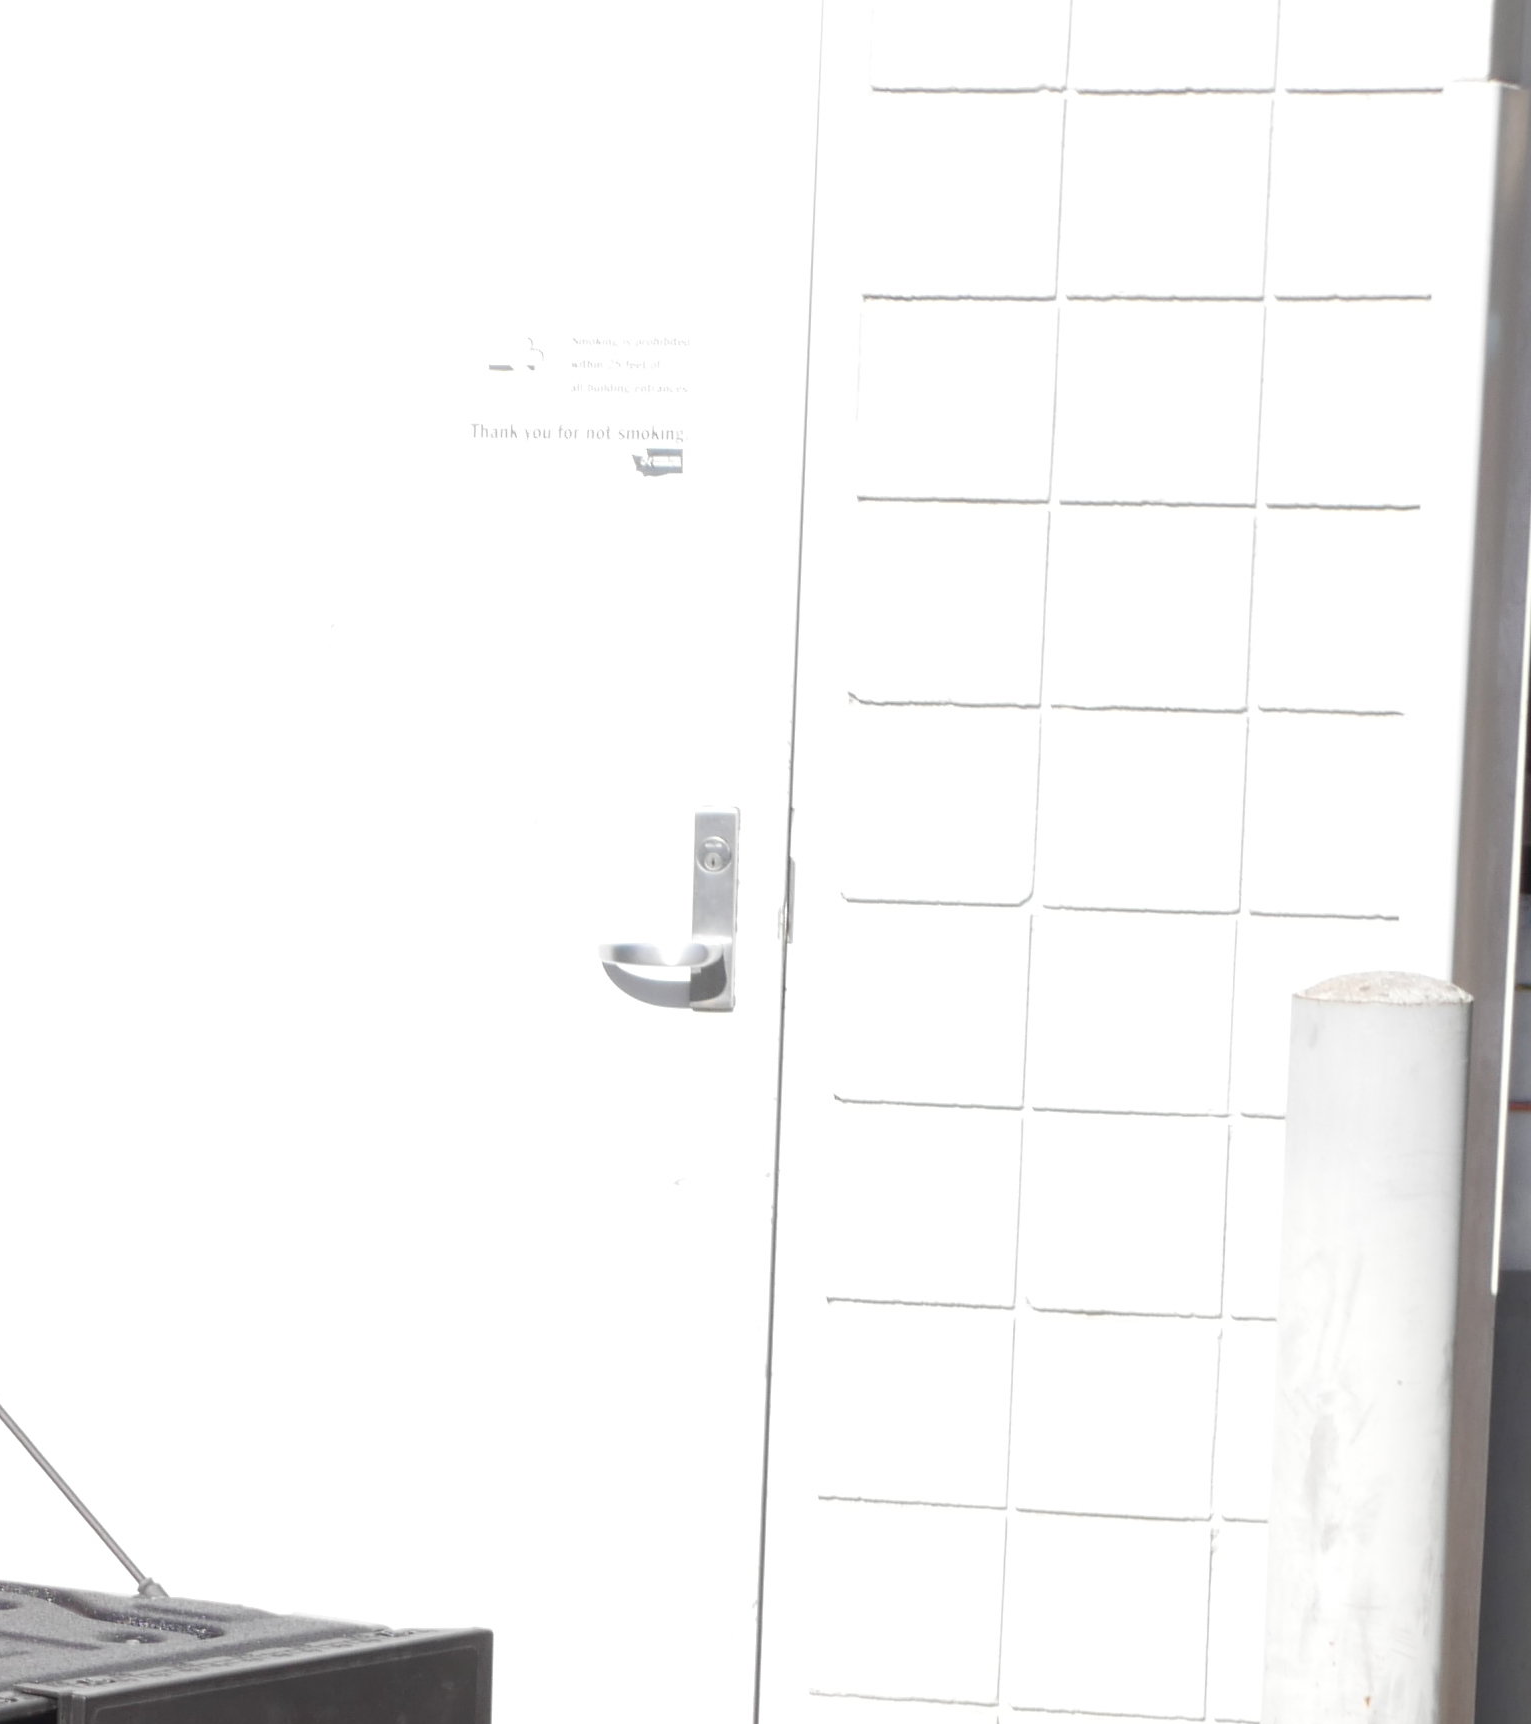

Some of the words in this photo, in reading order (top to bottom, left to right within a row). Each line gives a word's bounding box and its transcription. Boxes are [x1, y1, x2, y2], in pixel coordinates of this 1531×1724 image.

[471, 422, 518, 440] Thank
[524, 426, 551, 443] you
[558, 423, 578, 440] for
[587, 424, 610, 440] not
